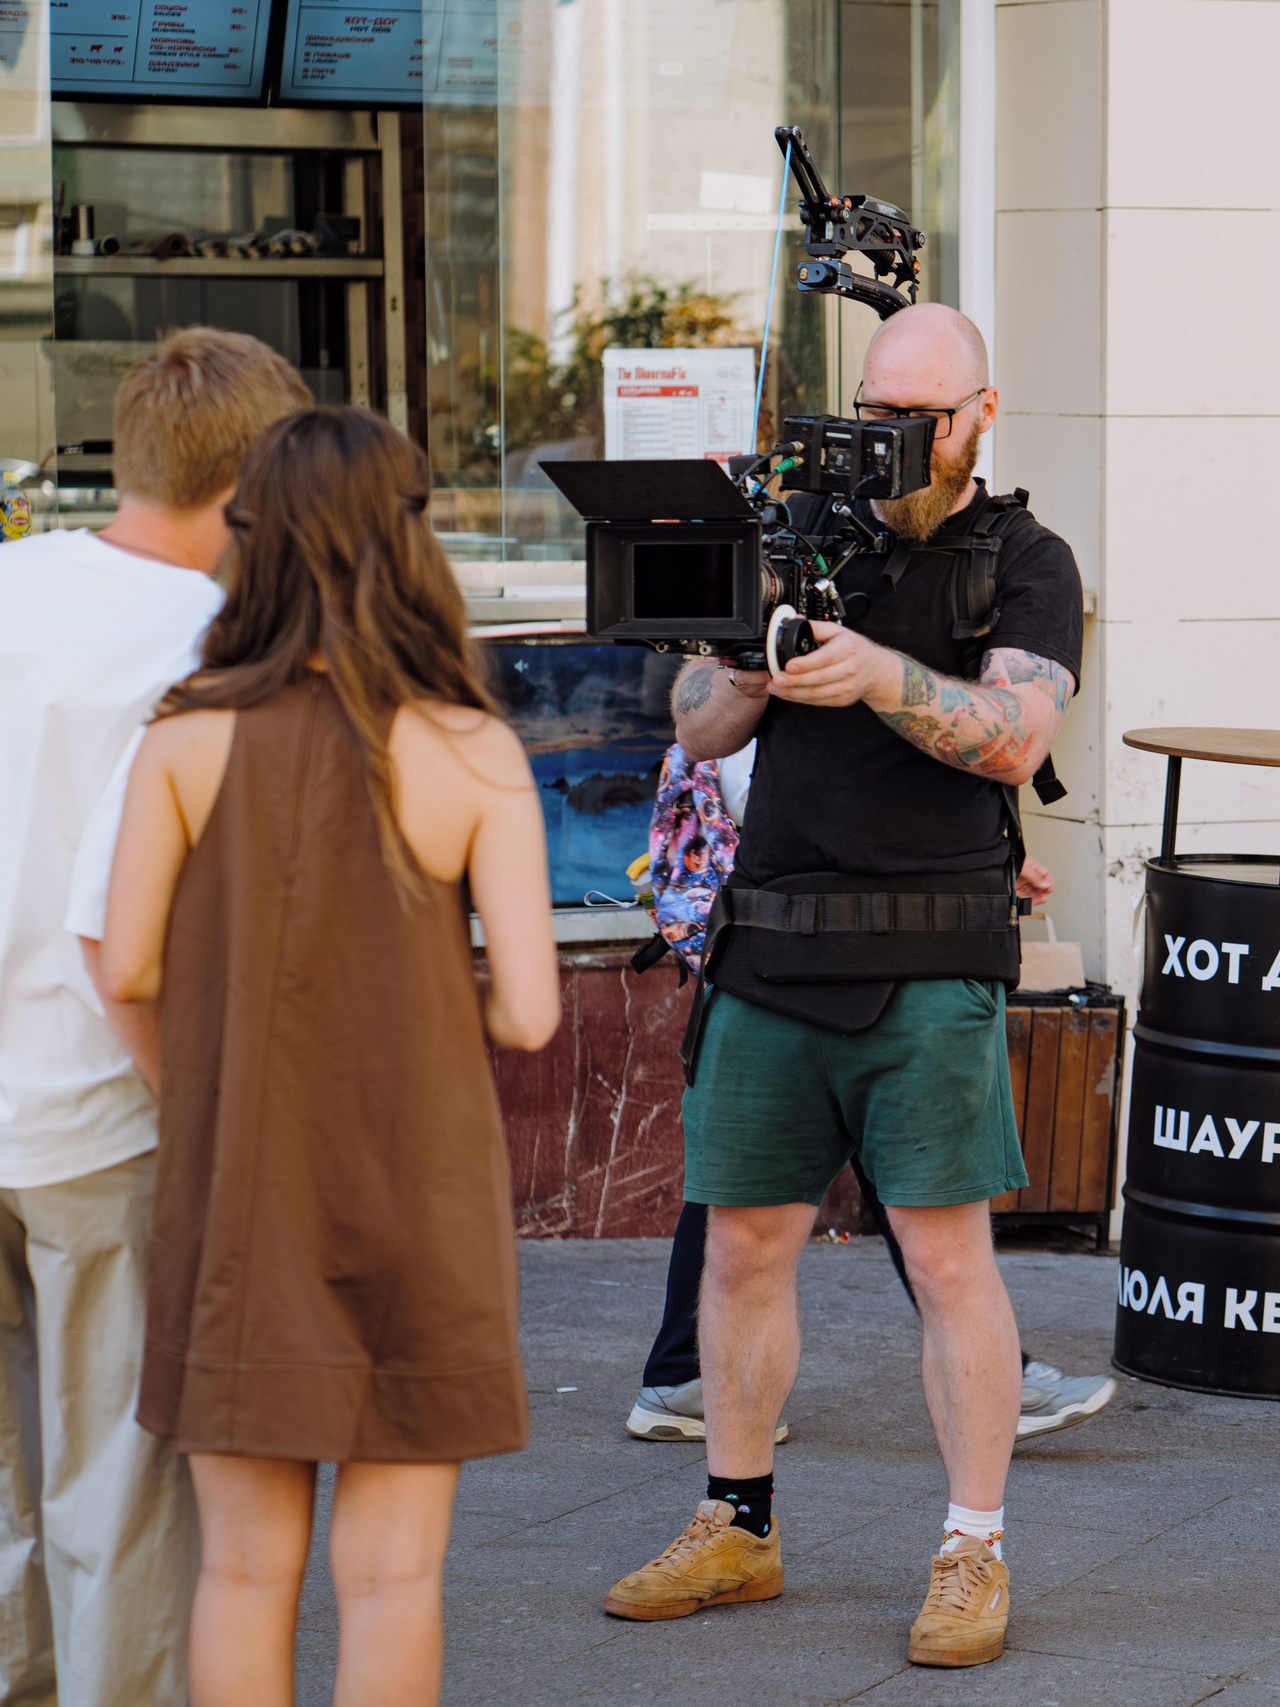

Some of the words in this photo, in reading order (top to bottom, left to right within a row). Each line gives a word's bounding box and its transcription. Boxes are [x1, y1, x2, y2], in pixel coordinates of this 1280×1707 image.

[344, 16, 399, 26] ХОТ-ДОГ
[617, 366, 632, 379] The
[1161, 934, 1250, 985] ХОТ
